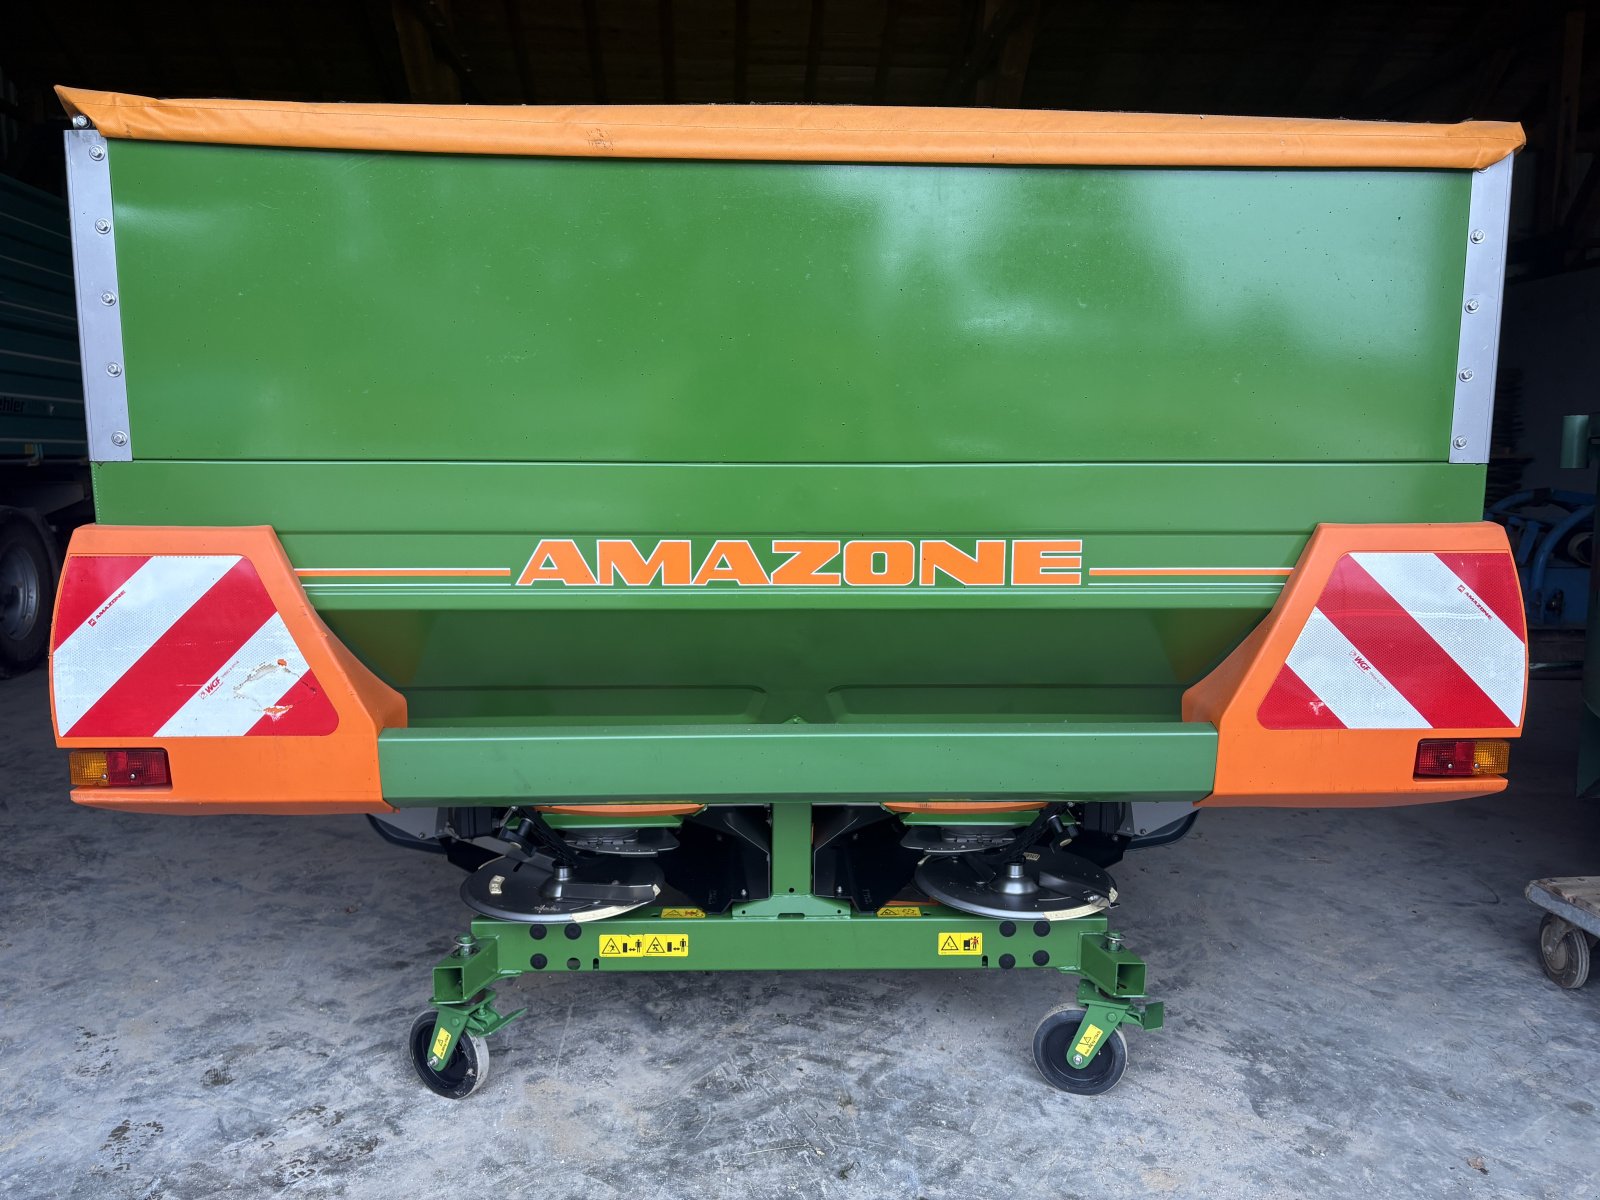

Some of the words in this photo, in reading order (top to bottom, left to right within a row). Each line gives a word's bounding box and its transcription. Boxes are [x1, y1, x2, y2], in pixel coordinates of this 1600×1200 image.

[516, 539, 1082, 586] AMAZONE
[96, 590, 126, 619] AMAZONE
[1465, 592, 1492, 620] AMAZONE
[1355, 656, 1371, 671] WGF
[205, 677, 221, 694] WGF
